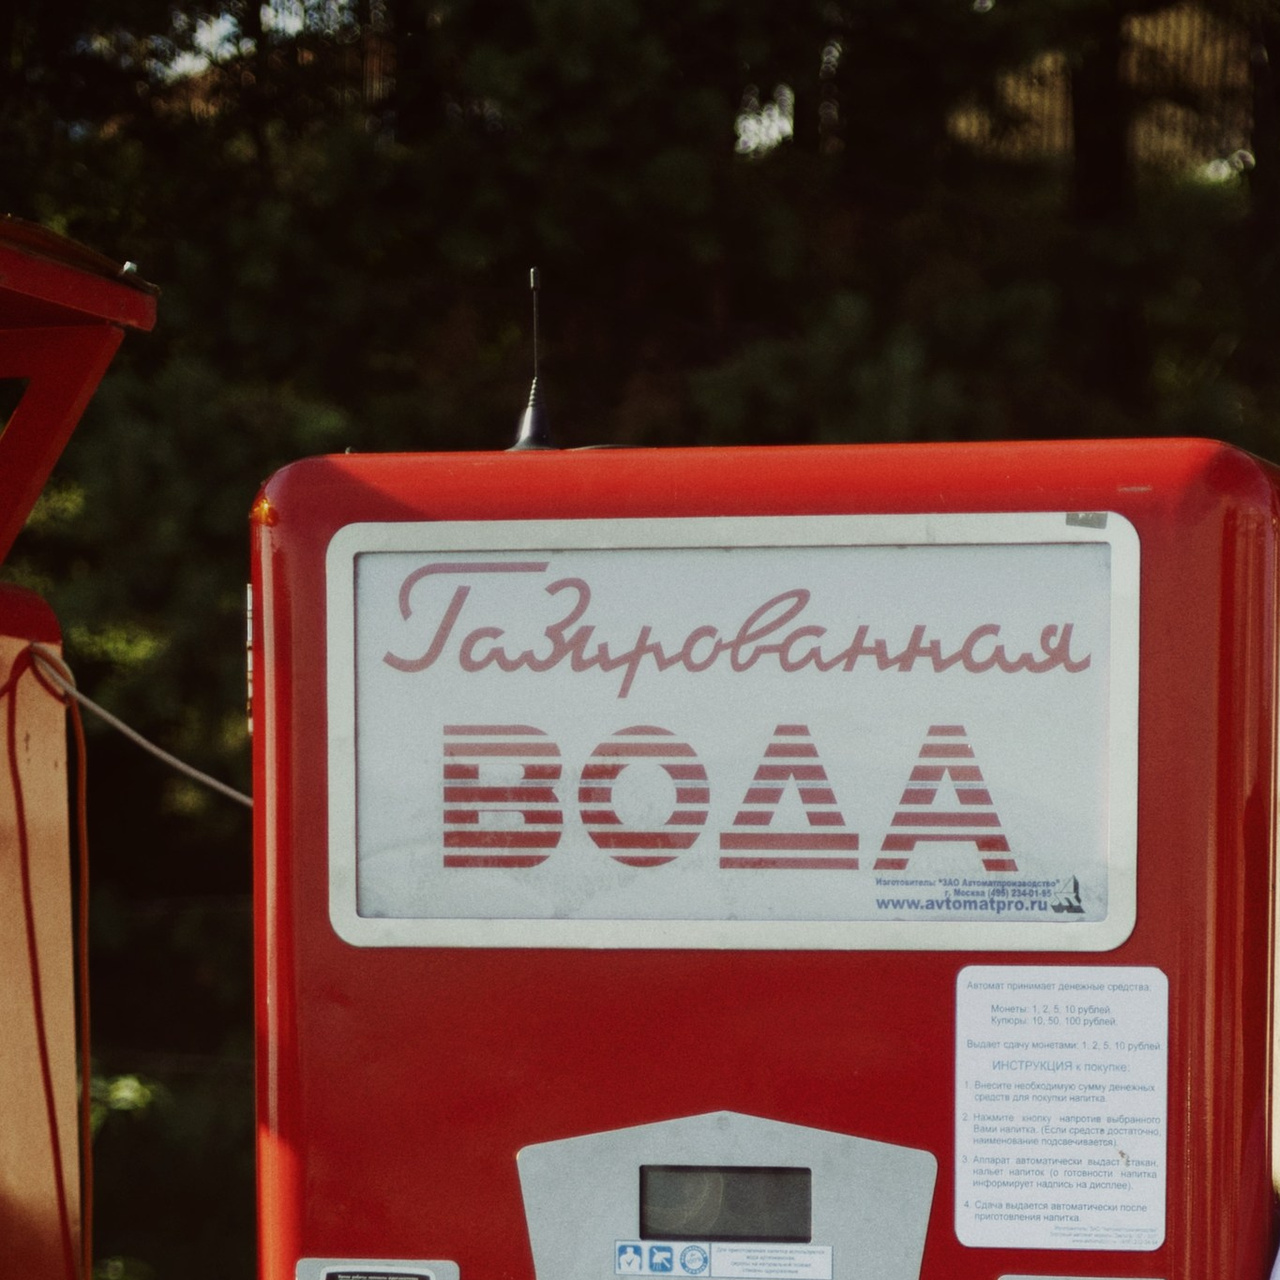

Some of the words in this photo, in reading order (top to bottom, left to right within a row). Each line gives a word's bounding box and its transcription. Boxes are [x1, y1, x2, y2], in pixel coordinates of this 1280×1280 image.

[382, 560, 1092, 700] Газированная
[442, 723, 1020, 872] ВОДА
[953, 889, 985, 897] Москва
[876, 898, 1048, 914] www.avtomatpro.ru
[966, 981, 1004, 990] Автомат
[1007, 983, 1056, 991] принимает
[1058, 983, 1105, 991] денежные
[1065, 1005, 1076, 1014] 10
[1065, 1016, 1081, 1026] 100
[966, 1039, 1001, 1049] Выдает
[1003, 1041, 1030, 1050] сдачу
[1115, 1041, 1126, 1050] 10
[992, 1060, 1073, 1073] ИНСТРУКЦИЯ
[1084, 1063, 1131, 1074] покупке:
[974, 1080, 1012, 1090] Внесите
[1014, 1081, 1076, 1092] необходимую
[1078, 1083, 1107, 1093] сумму
[1108, 1083, 1155, 1092] денежных
[974, 1094, 1010, 1102] средств
[1012, 1094, 1029, 1102] для
[1032, 1094, 1067, 1103] покупки
[973, 1112, 1015, 1122] Нажмите
[1022, 1115, 1052, 1124] кнопку
[1059, 1116, 1102, 1124] напротив
[1106, 1114, 1161, 1125] выбранного
[973, 1124, 998, 1133] Вами
[1041, 1125, 1067, 1135] (Если
[1069, 1127, 1105, 1135] средств
[973, 1137, 1039, 1145] наименование
[973, 1155, 1010, 1166] Аппарат
[1015, 1157, 1082, 1166] автоматически
[1087, 1158, 1120, 1167] выдаст
[973, 1168, 1004, 1176] нальет
[1120, 1171, 1157, 1179] напитка
[973, 1180, 1034, 1190] информирует
[1036, 1181, 1074, 1189] надпись
[974, 1200, 1003, 1210] Сдача
[1005, 1202, 1048, 1210] выдается
[1050, 1203, 1118, 1211] автоматически
[1119, 1204, 1148, 1212] после
[974, 1213, 1041, 1222] приготовления
